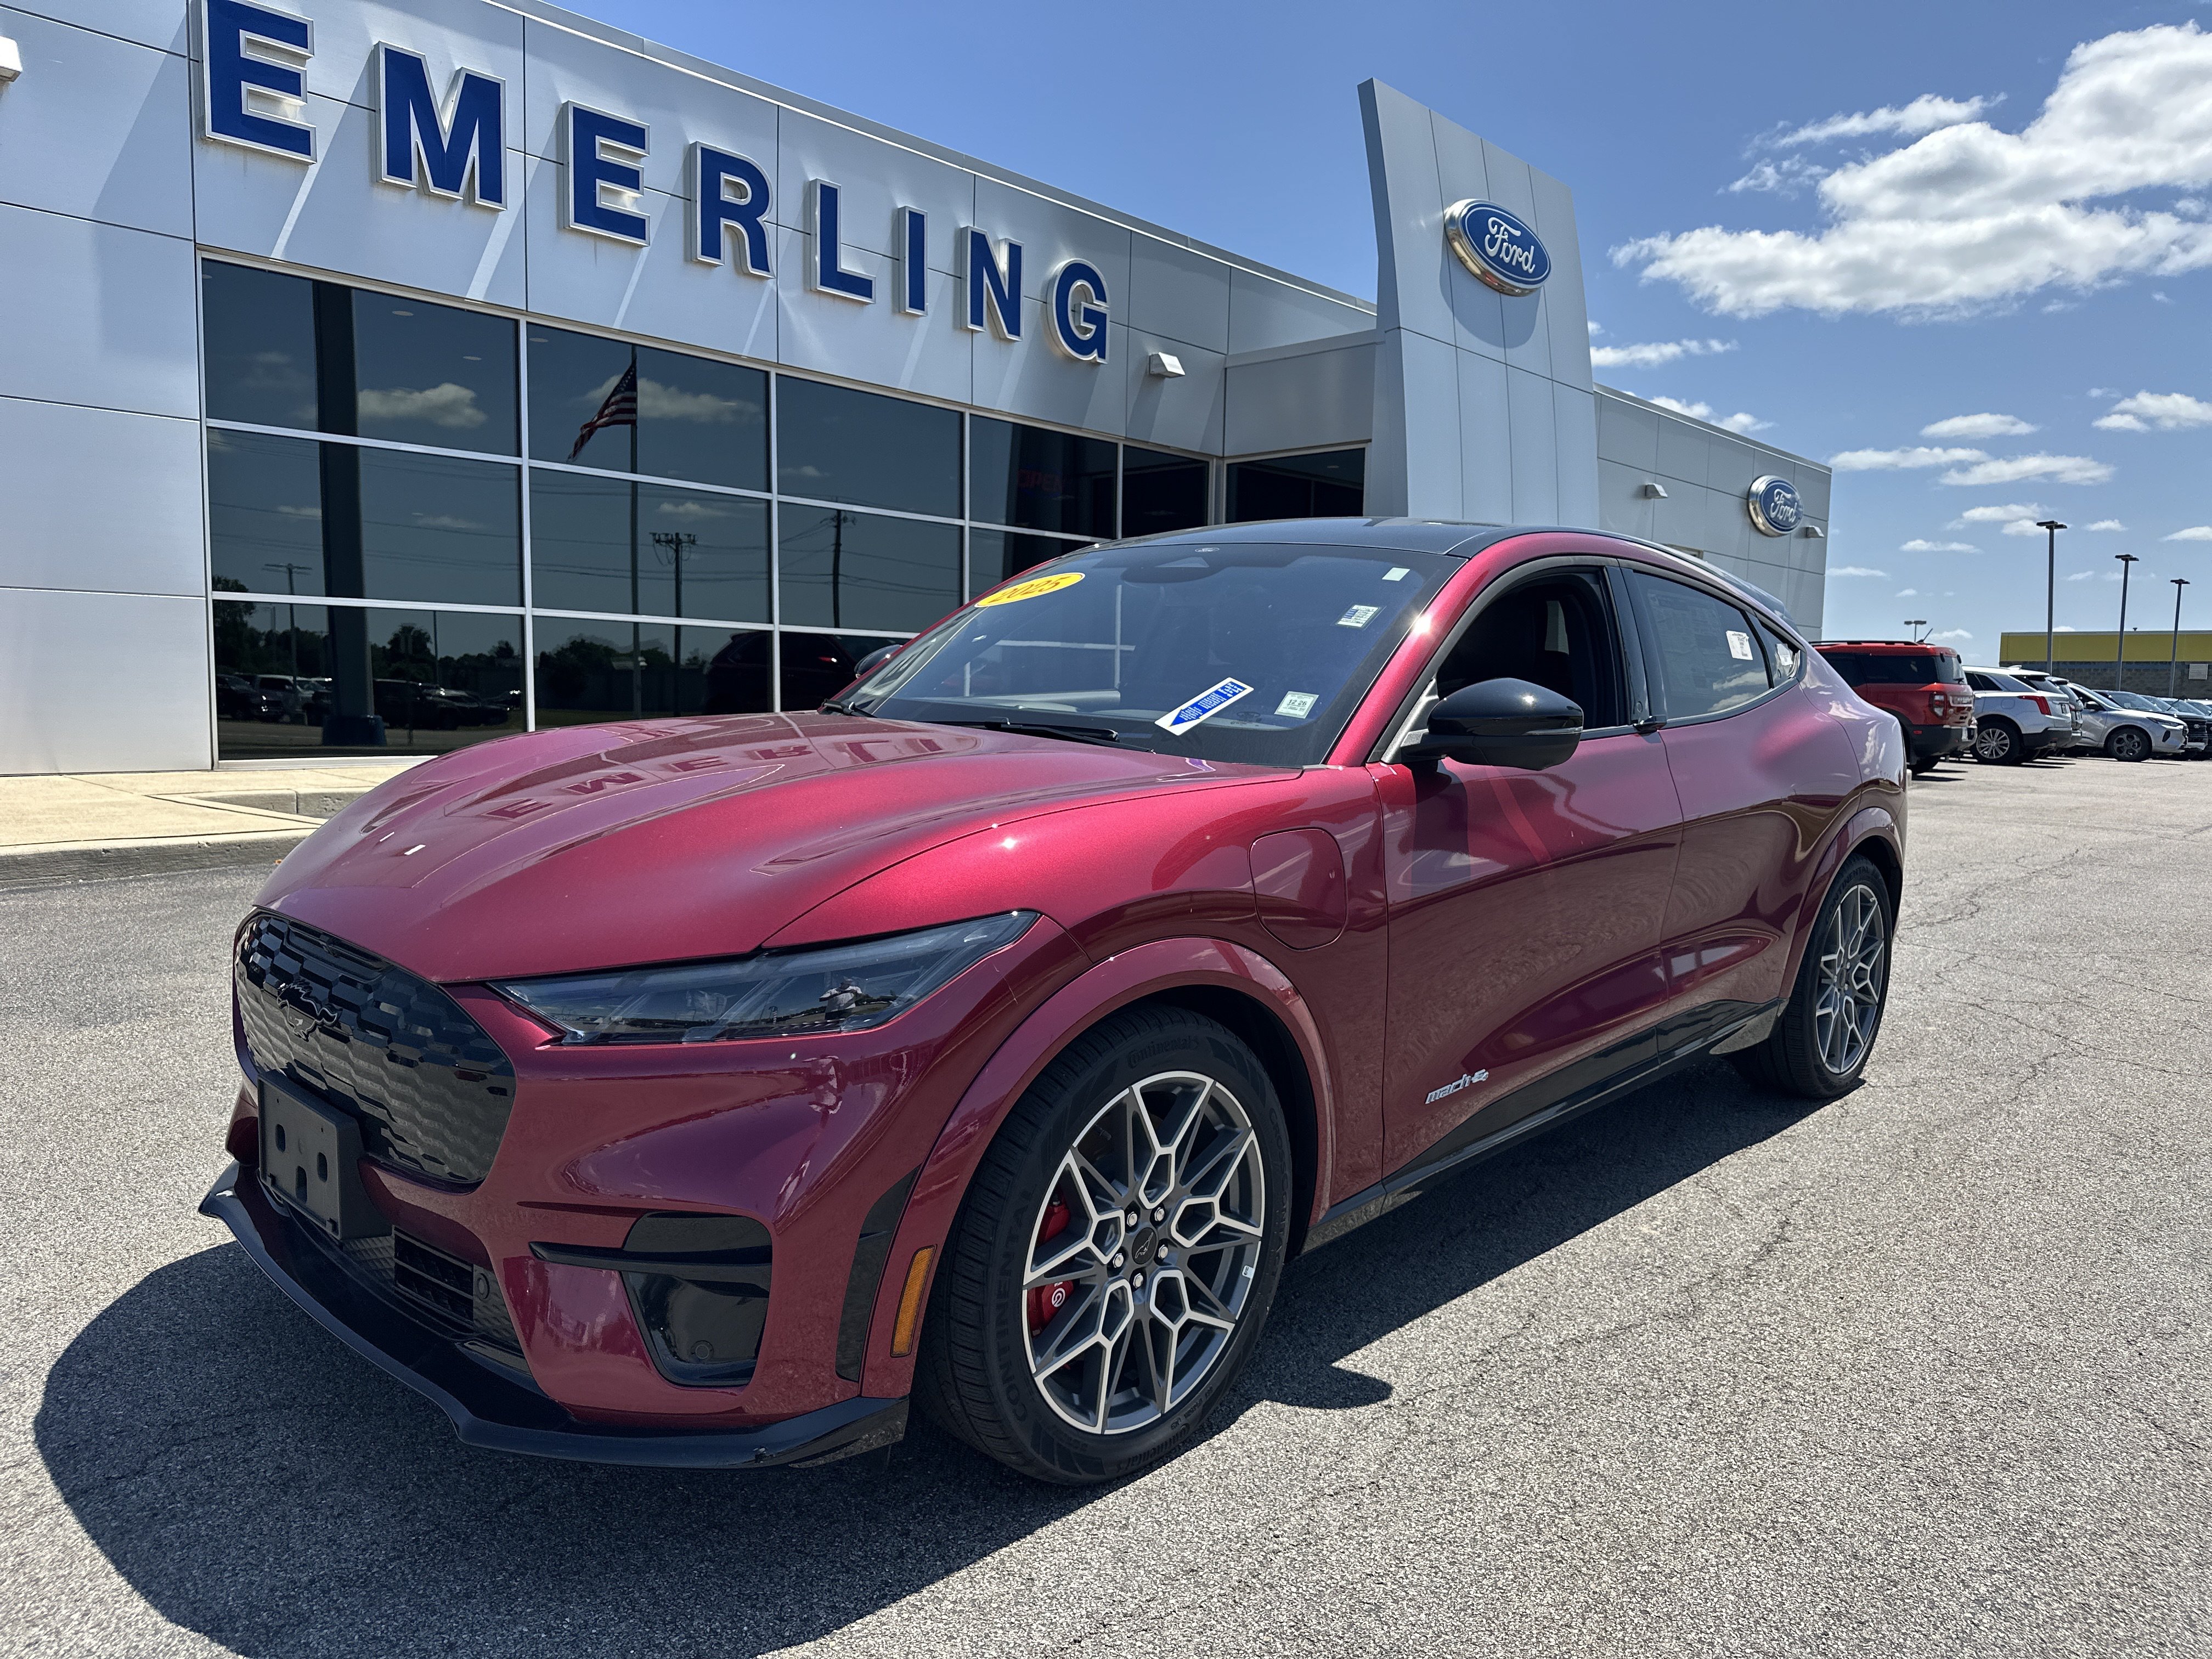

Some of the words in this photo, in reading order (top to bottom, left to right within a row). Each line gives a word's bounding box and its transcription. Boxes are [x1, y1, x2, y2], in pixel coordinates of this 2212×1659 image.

[202, 0, 1109, 364] EMERLING
[1485, 217, 1536, 273] Ford
[1770, 488, 1798, 523] Ford
[988, 576, 1072, 603] 2025
